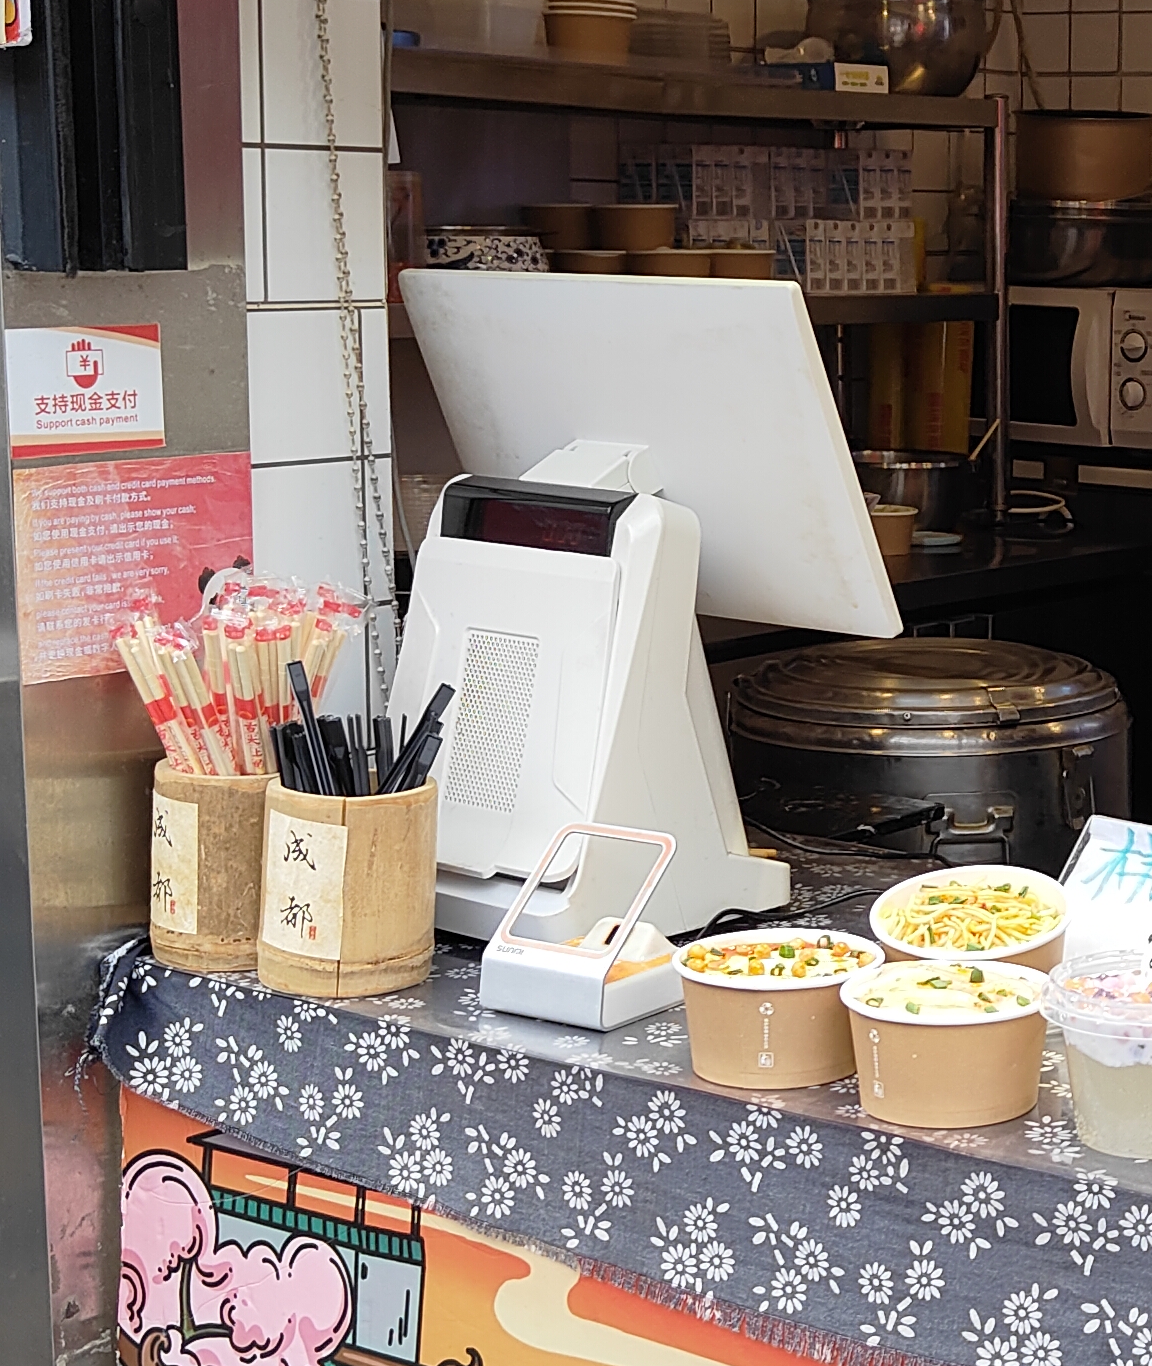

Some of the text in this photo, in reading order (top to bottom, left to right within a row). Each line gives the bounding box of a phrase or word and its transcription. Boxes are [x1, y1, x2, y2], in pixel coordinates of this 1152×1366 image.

[34, 389, 138, 416] 支持现金支付
[36, 413, 138, 430] Support cash payment
[72, 485, 87, 493] both
[89, 483, 106, 492] cash
[121, 480, 141, 489] credit
[142, 479, 155, 488] card
[158, 477, 184, 488] payment
[53, 517, 63, 525] are
[66, 514, 89, 525] paying
[90, 513, 98, 523] by
[120, 509, 142, 520] please
[144, 507, 161, 516] show
[162, 507, 176, 517] your
[33, 547, 57, 557] Please
[59, 544, 86, 556] present
[88, 543, 102, 553] your
[104, 540, 123, 550] credit
[125, 539, 139, 548] card
[146, 538, 158, 547] you
[54, 576, 73, 585] credit
[75, 574, 90, 583] card
[134, 569, 148, 578] very
[153, 807, 173, 913] 成都
[280, 830, 317, 939] 成都
